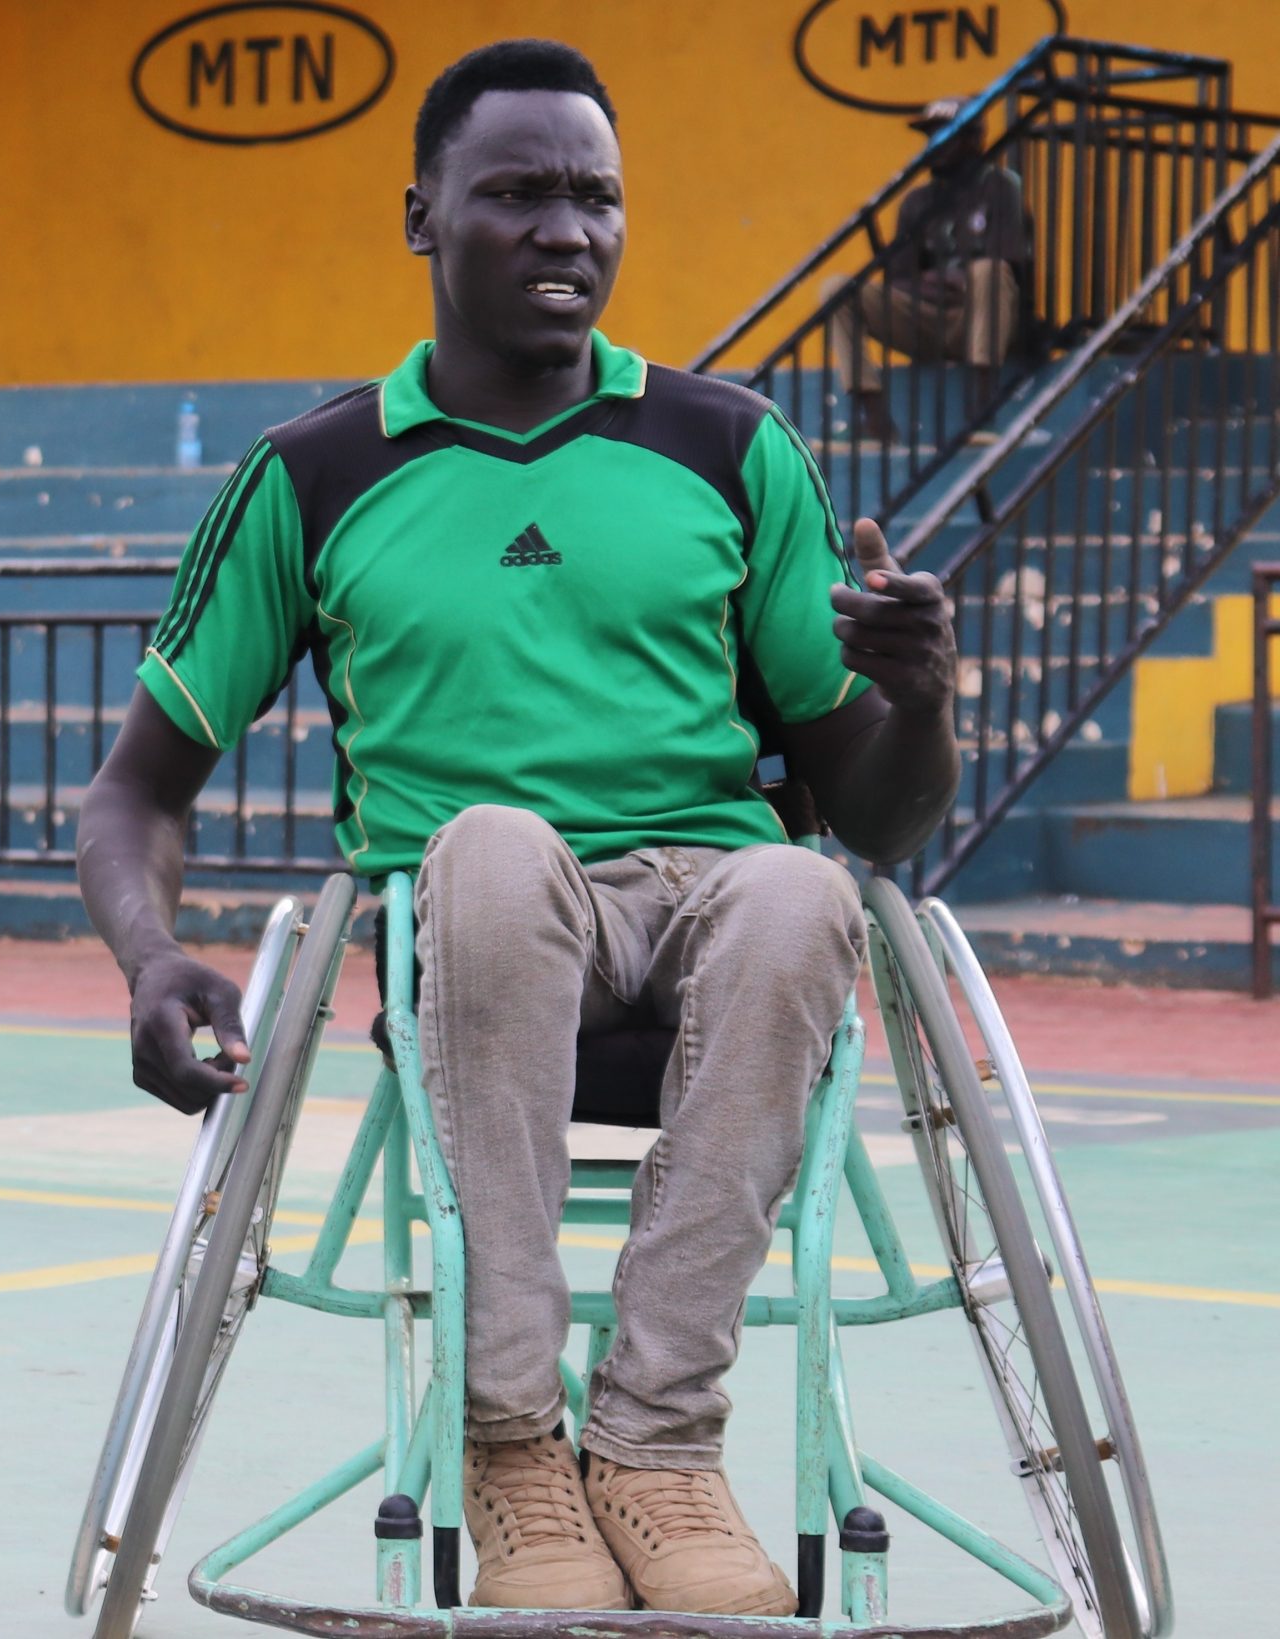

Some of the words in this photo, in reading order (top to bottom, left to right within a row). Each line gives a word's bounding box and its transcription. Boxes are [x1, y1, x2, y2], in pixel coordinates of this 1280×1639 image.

[857, 5, 998, 68] MTN
[187, 33, 335, 107] MTN
[500, 551, 563, 567] adidas
